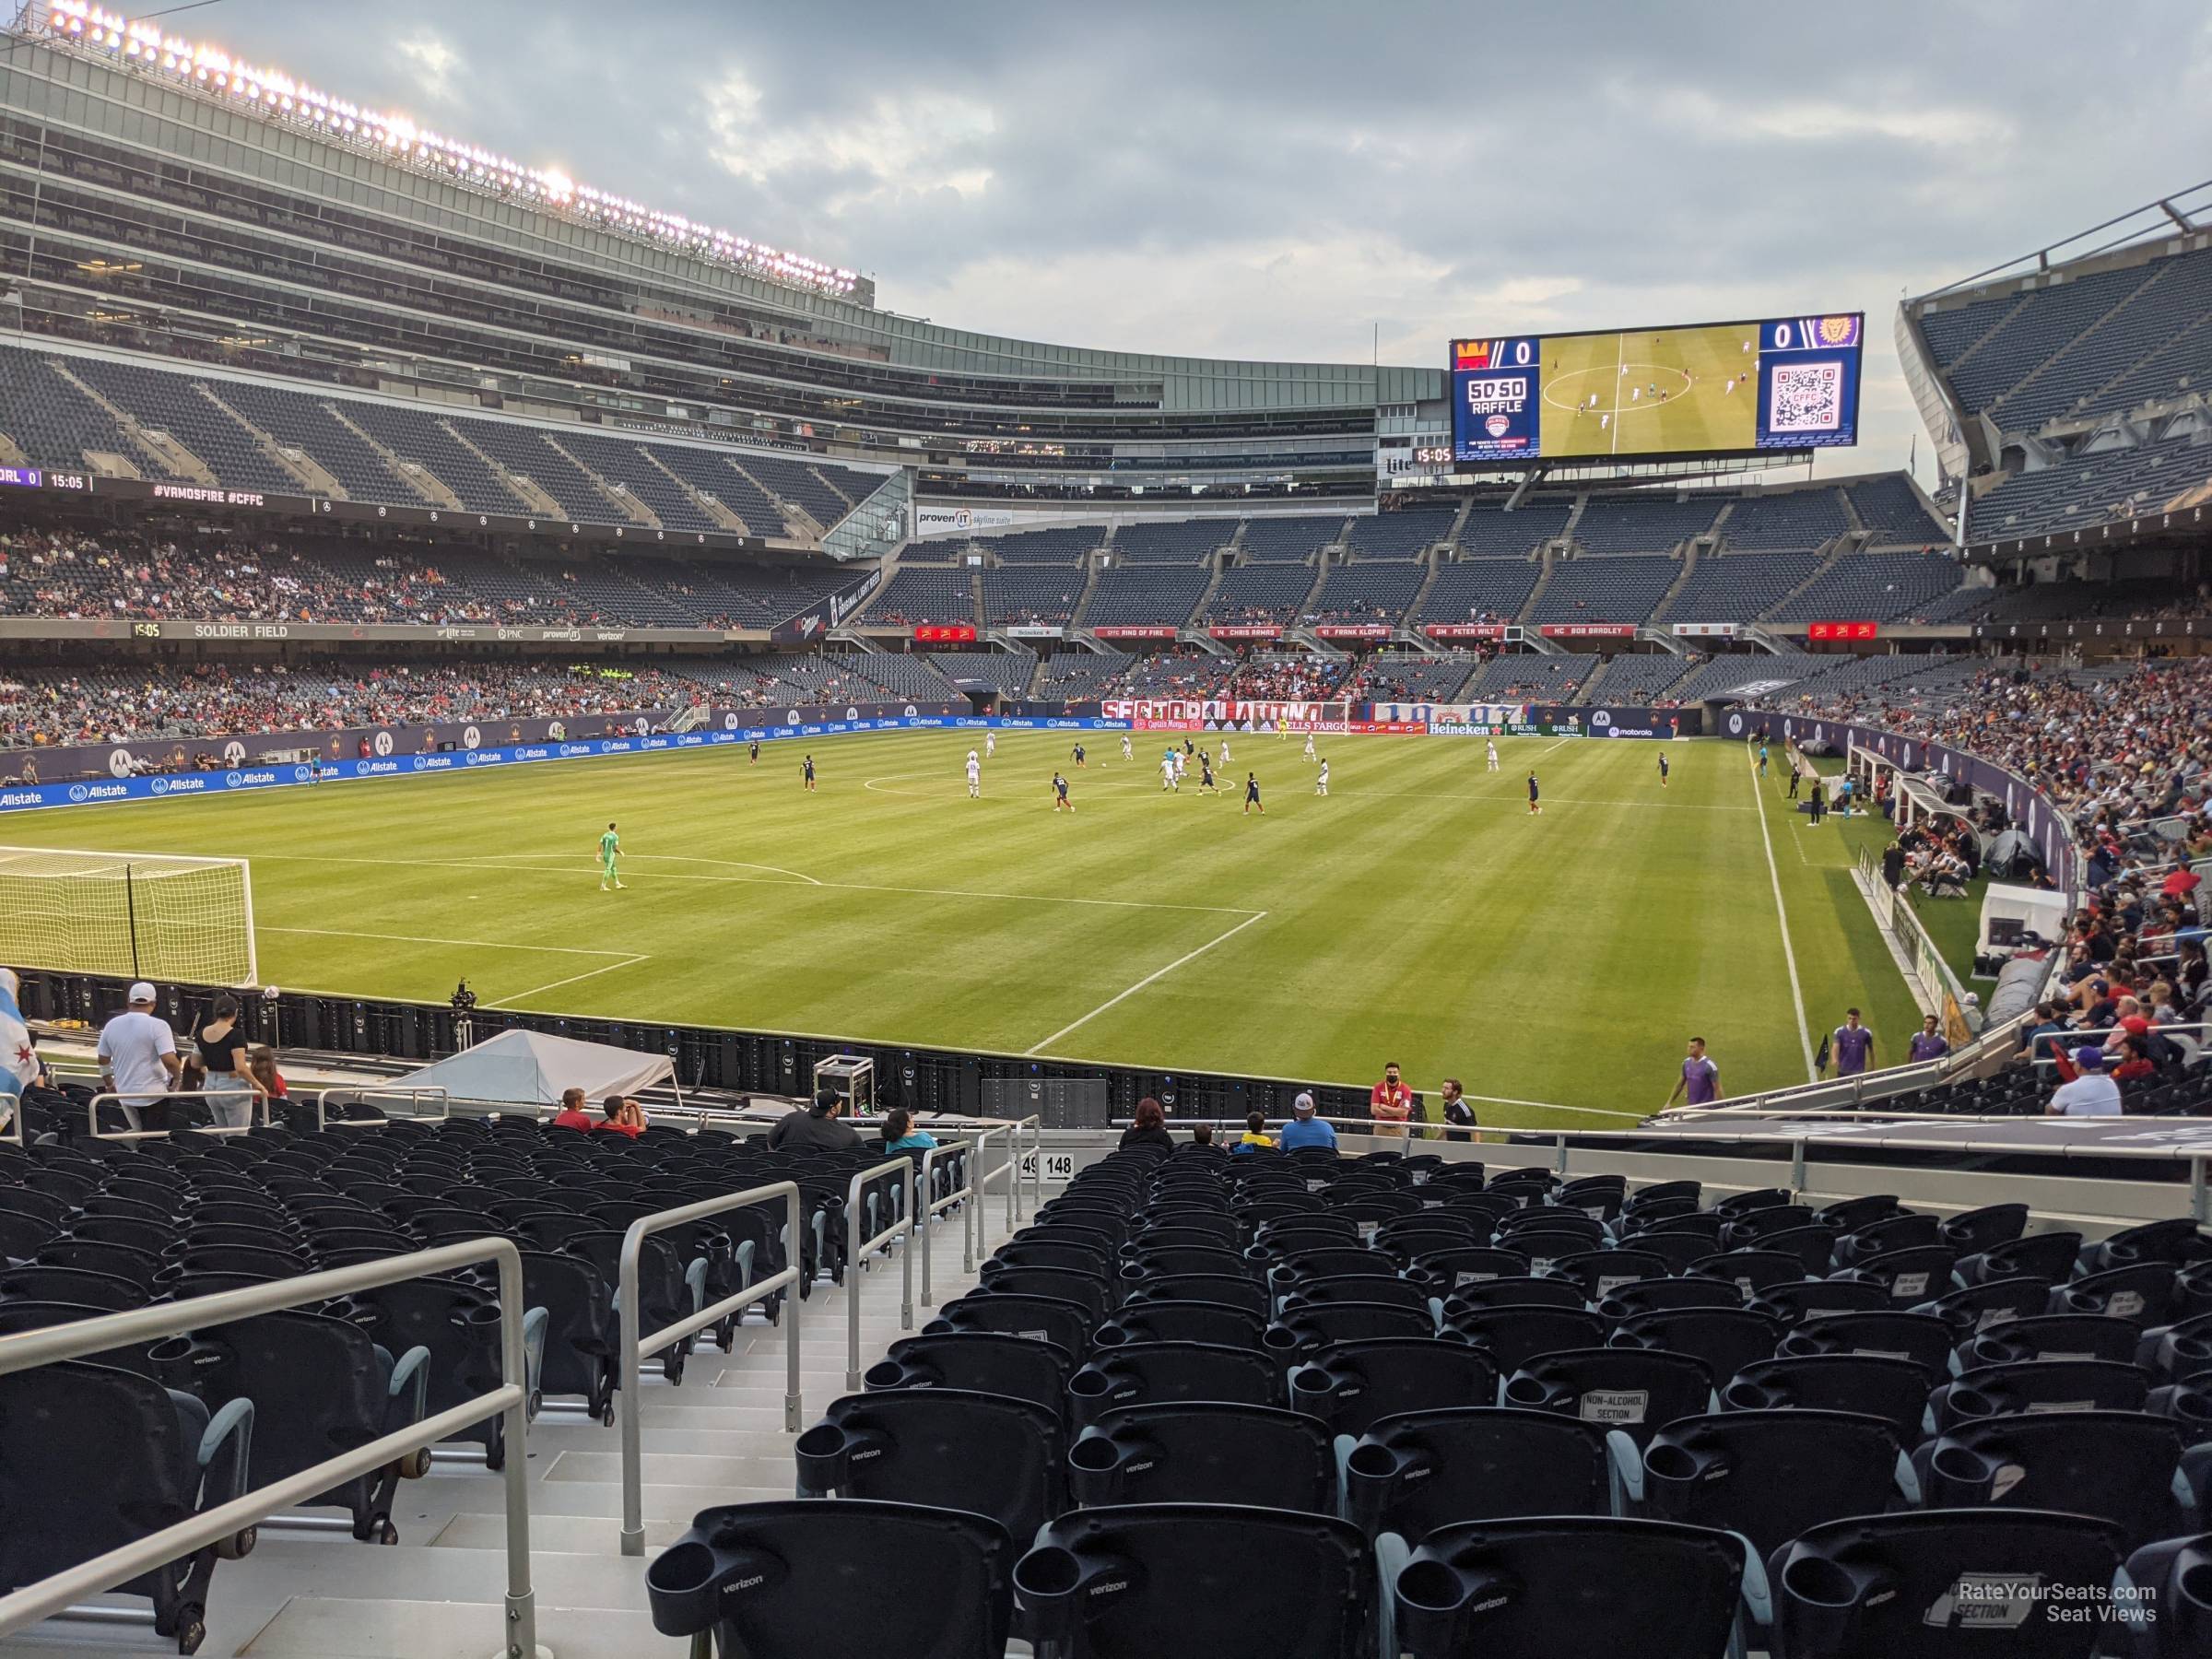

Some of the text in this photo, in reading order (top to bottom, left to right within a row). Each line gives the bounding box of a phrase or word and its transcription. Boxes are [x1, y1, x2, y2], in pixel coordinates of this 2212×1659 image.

[1774, 324, 1791, 348] 0
[1516, 342, 1530, 365] 0
[1793, 394, 1818, 402] CFFC
[1472, 400, 1523, 415] RAFFLE
[1418, 448, 1452, 462] 15:05
[1385, 457, 1413, 475] Lite
[29, 472, 37, 485] 0
[51, 474, 84, 489] 15:05
[154, 485, 265, 507] #VAMOSFIRE #CFFC
[919, 513, 956, 524] proven
[973, 516, 995, 526] skyline
[135, 623, 160, 637] 15:05
[194, 625, 288, 638] SOLDIER FIELD
[447, 628, 460, 638] Lite
[507, 630, 524, 639] PNC
[597, 630, 624, 641] verizon
[1217, 629, 1276, 637] 14 CHRIS ARMAS
[1436, 628, 1447, 636] GM
[1453, 628, 1476, 636] PETER
[1554, 627, 1565, 635] HC
[1588, 627, 1623, 635] BRADLEY
[1148, 720, 1188, 729] Captain Morgan
[1313, 722, 1347, 732] FARGO
[1430, 723, 1488, 735] Heineken
[1558, 724, 1579, 733] RUSH
[719, 733, 735, 741] Allstate
[751, 730, 766, 738] Allstate
[1619, 728, 1653, 736] motorola
[611, 741, 630, 750] Allstate
[650, 738, 667, 747] Allstate
[685, 735, 702, 744] Allstate
[525, 748, 547, 758] Allstate
[570, 745, 590, 754] Allstate
[426, 757, 452, 768] Allstate
[477, 752, 501, 763] Allstate
[371, 760, 397, 772] Allstate
[241, 772, 276, 784] Allstate
[169, 779, 205, 791] Allstate
[88, 785, 127, 798] Allstate
[0, 792, 42, 807] Allstate
[1047, 1157, 1072, 1173] 148
[355, 1315, 377, 1324] verizon
[194, 1356, 221, 1365] verizon
[1114, 1390, 1136, 1399] verizon
[1338, 1388, 1359, 1397] verizon
[1586, 1394, 1642, 1406] NON-ALCOHOL
[1596, 1408, 1630, 1419] SECTION
[852, 1449, 881, 1462] verizon
[1125, 1462, 1153, 1474] verizon
[1405, 1468, 1430, 1480] verizon
[723, 1575, 763, 1594] verizon
[1089, 1581, 1127, 1595] verizon
[1473, 1596, 1508, 1613] verizon
[1956, 1604, 2010, 1620] SECTION
